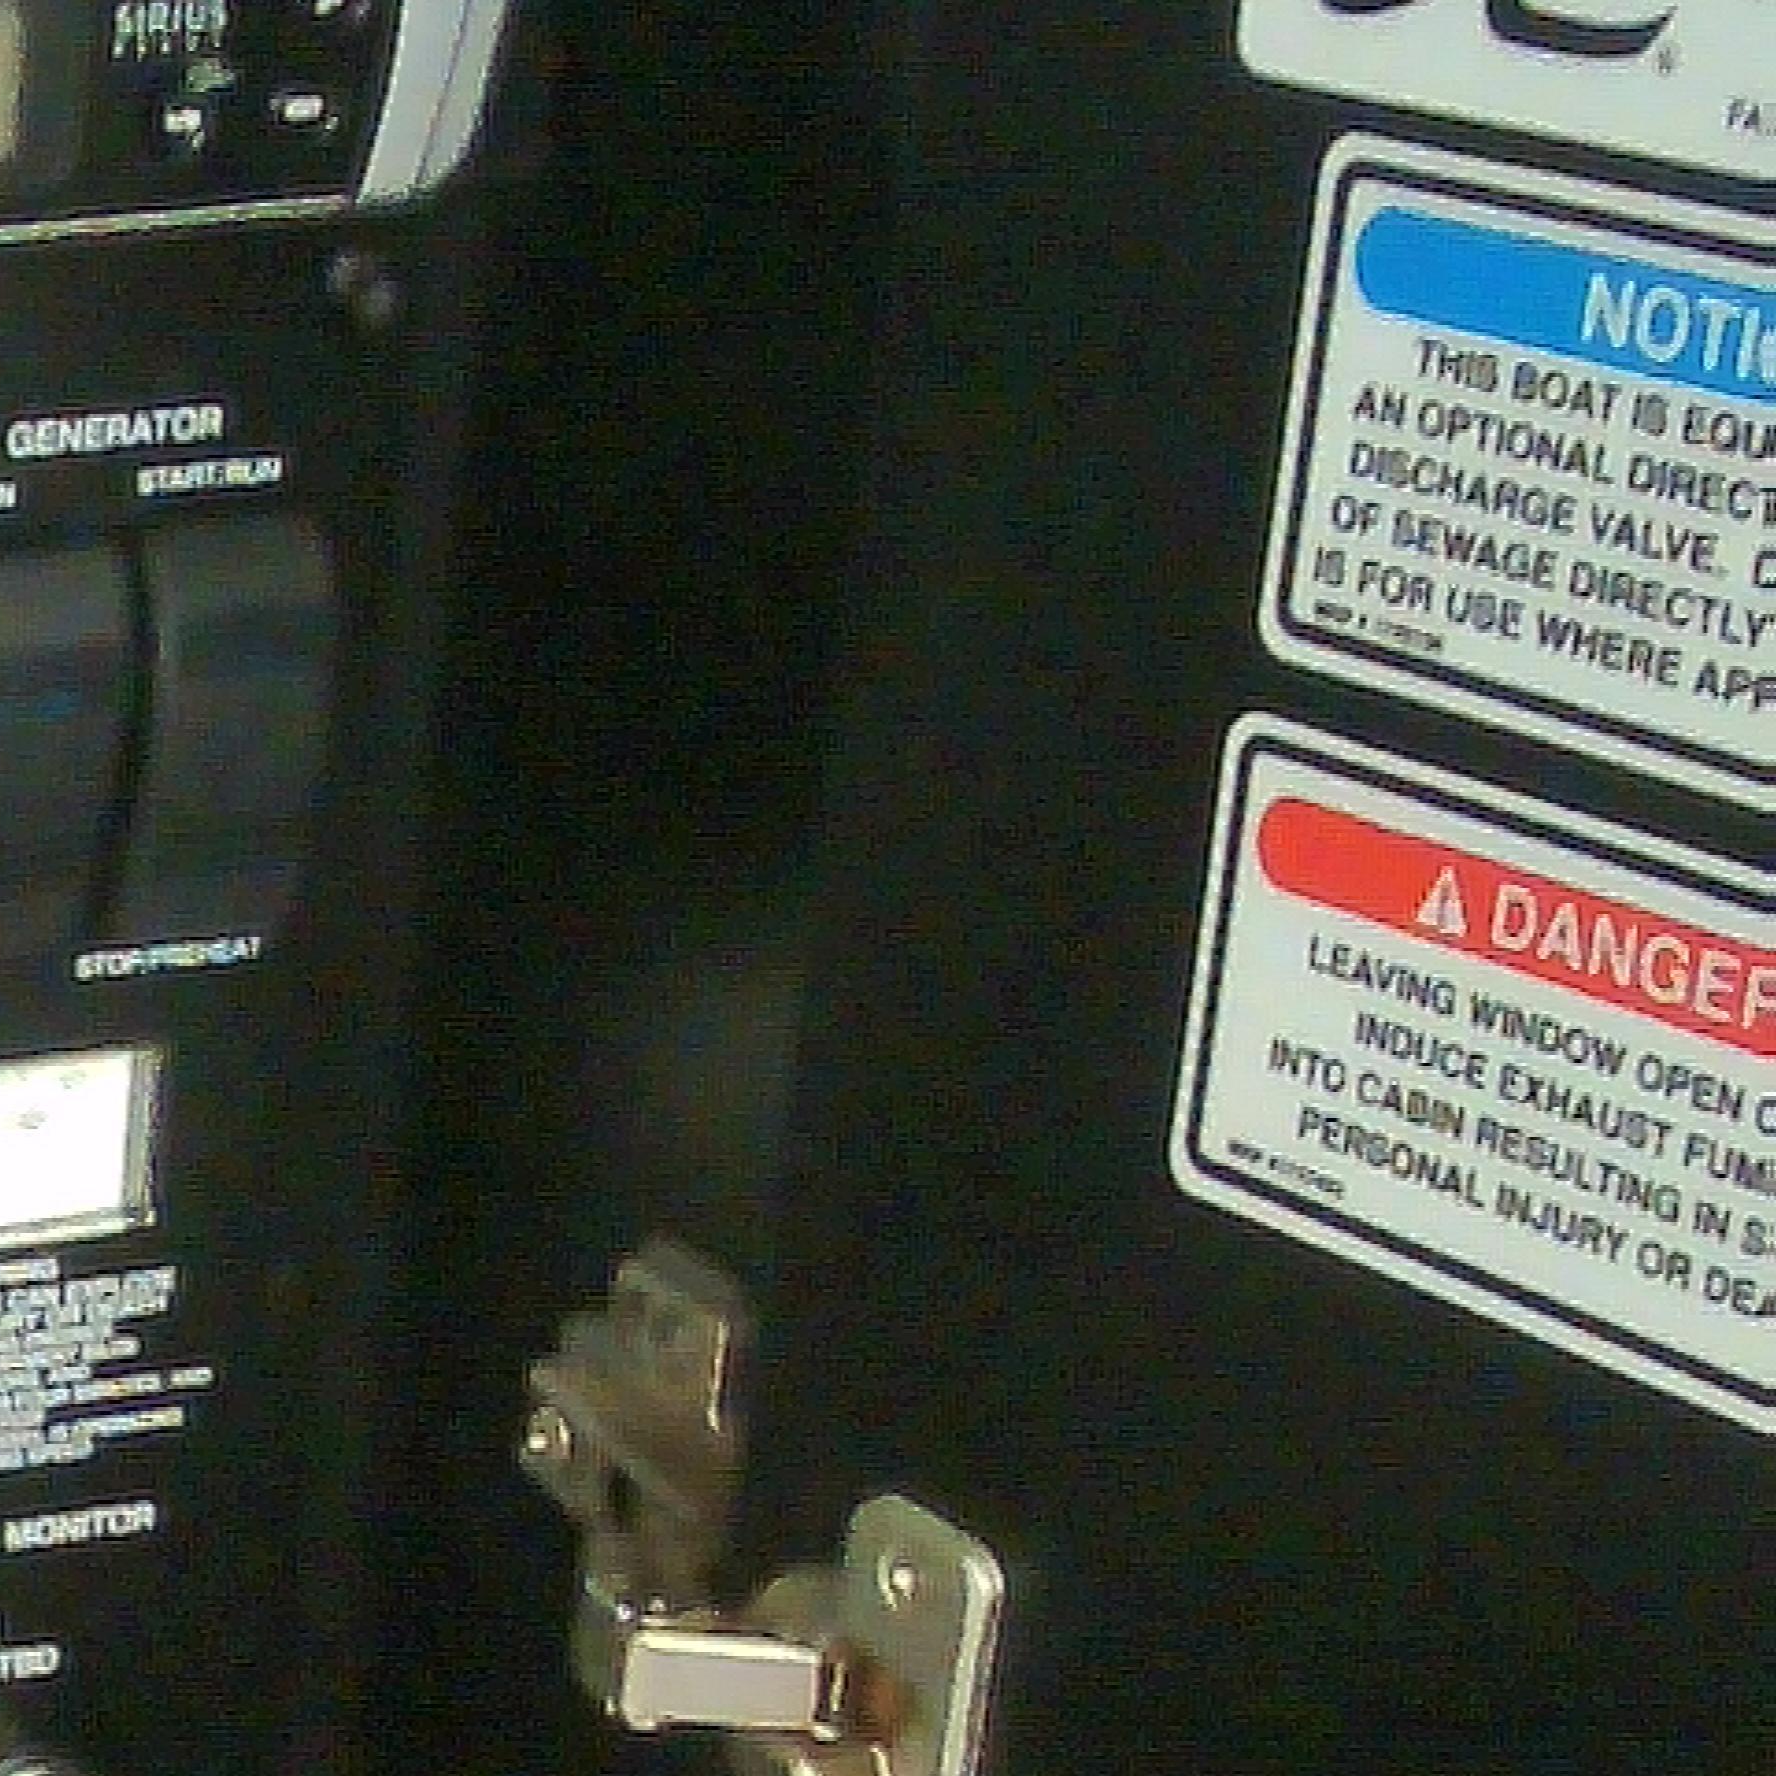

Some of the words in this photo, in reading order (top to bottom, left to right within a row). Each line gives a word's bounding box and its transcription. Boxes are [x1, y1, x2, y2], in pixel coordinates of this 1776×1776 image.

[6, 404, 225, 459] GENERATOR
[1351, 382, 1406, 428] AN
[1418, 397, 1616, 486] OPTIONAL
[1415, 336, 1499, 393] THIS
[1511, 361, 1620, 422] BOAT
[1631, 393, 1668, 437] IS
[1348, 440, 1575, 533] DISCHARGE
[1314, 545, 1345, 588] IS
[1358, 558, 1433, 611] FOR
[1448, 584, 1522, 641] USE
[1535, 607, 1681, 687] WHERE
[1330, 494, 1374, 535] OF
[1391, 507, 1557, 592] SEWAGE
[1568, 558, 1774, 648] DIRECTLY
[1307, 932, 1456, 1018] LEAVING
[1468, 990, 1628, 1079] WINDOW
[1634, 1053, 1744, 1123] OPEN
[1354, 1011, 1486, 1092] INDUCE
[1499, 1062, 1673, 1158] EXHAUST
[1268, 1036, 1348, 1095] INTO
[1354, 1072, 1466, 1144] CABIN
[1474, 1111, 1681, 1224] RESULTING
[1691, 1199, 1733, 1245] IN
[1745, 1217, 1776, 1260] S
[1296, 1103, 1484, 1210] PERSONAL
[1495, 1187, 1628, 1265] INJURY
[1634, 1241, 1693, 1291] OR
[3, 1500, 158, 1554] MONITOR
